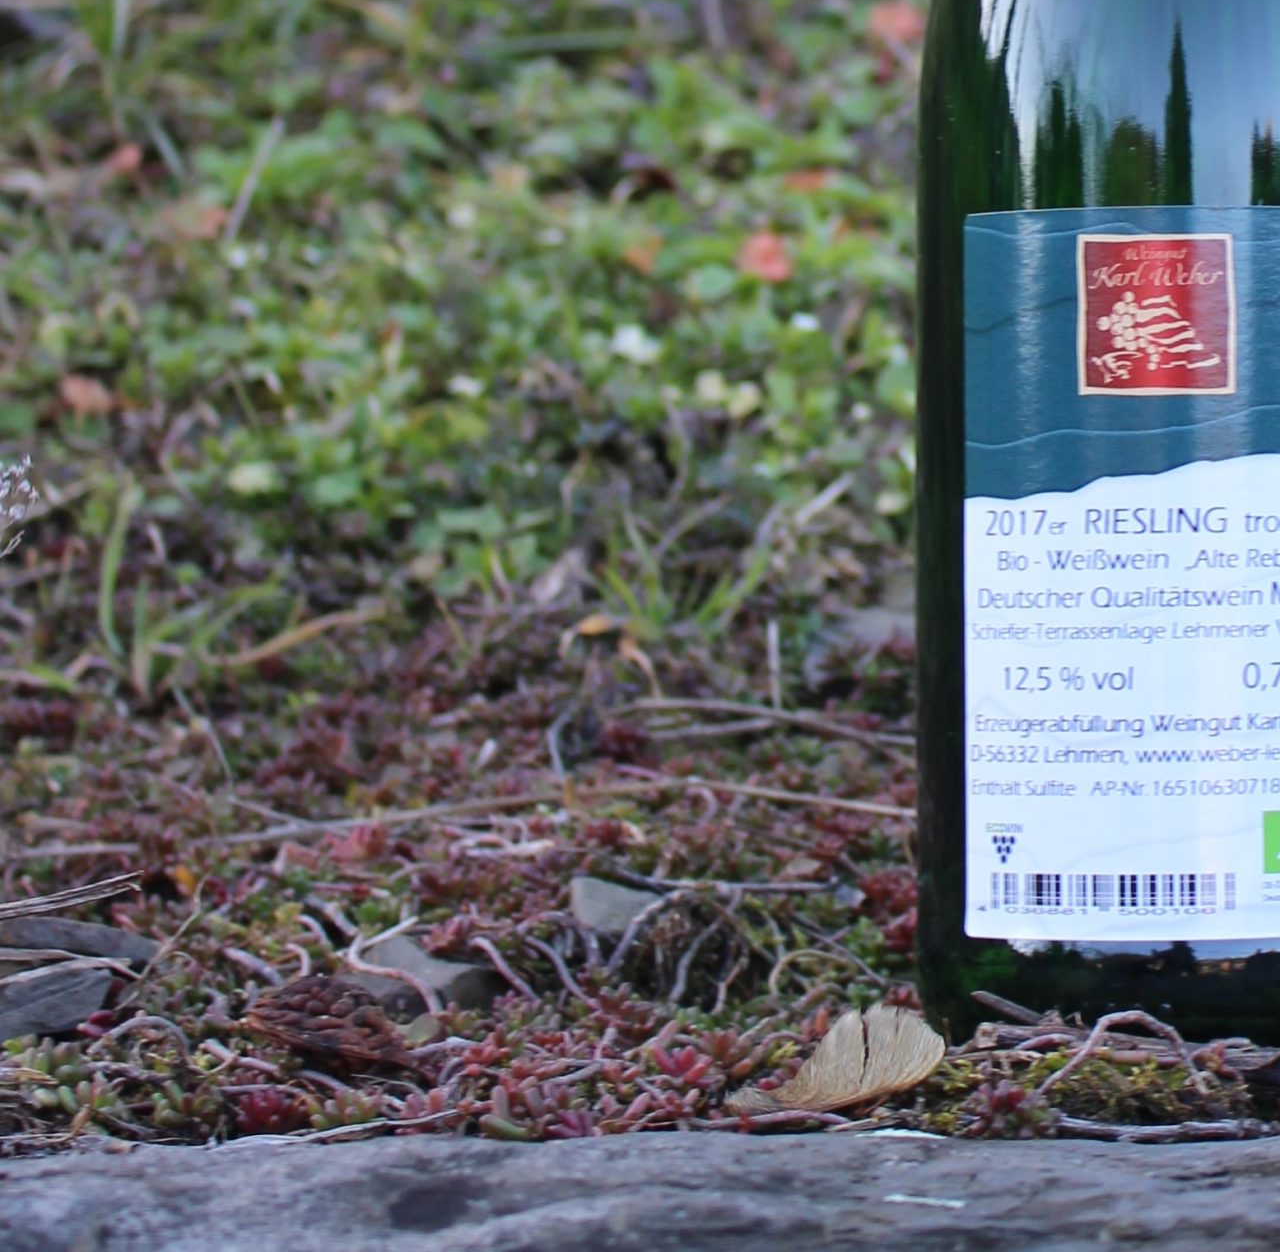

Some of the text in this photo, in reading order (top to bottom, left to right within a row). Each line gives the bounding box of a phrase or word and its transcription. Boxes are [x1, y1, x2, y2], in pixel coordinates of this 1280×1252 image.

[1088, 261, 1224, 289] Karl Weber
[1084, 506, 1228, 535] RIESLING
[997, 550, 1028, 571] Bio
[1047, 549, 1170, 571] Weißwein
[976, 588, 1084, 609] Deutscher
[1090, 584, 1264, 610] Qualitätswein
[1171, 620, 1269, 640] Lehmener
[1002, 666, 1134, 694] 12,5 % vol
[974, 713, 1144, 738] Erzeugerabfüllung
[1150, 712, 1242, 737] Weingut
[970, 745, 1039, 764] D-56332
[1044, 744, 1129, 766] Lehmen,
[1025, 779, 1077, 797] Sulfite
